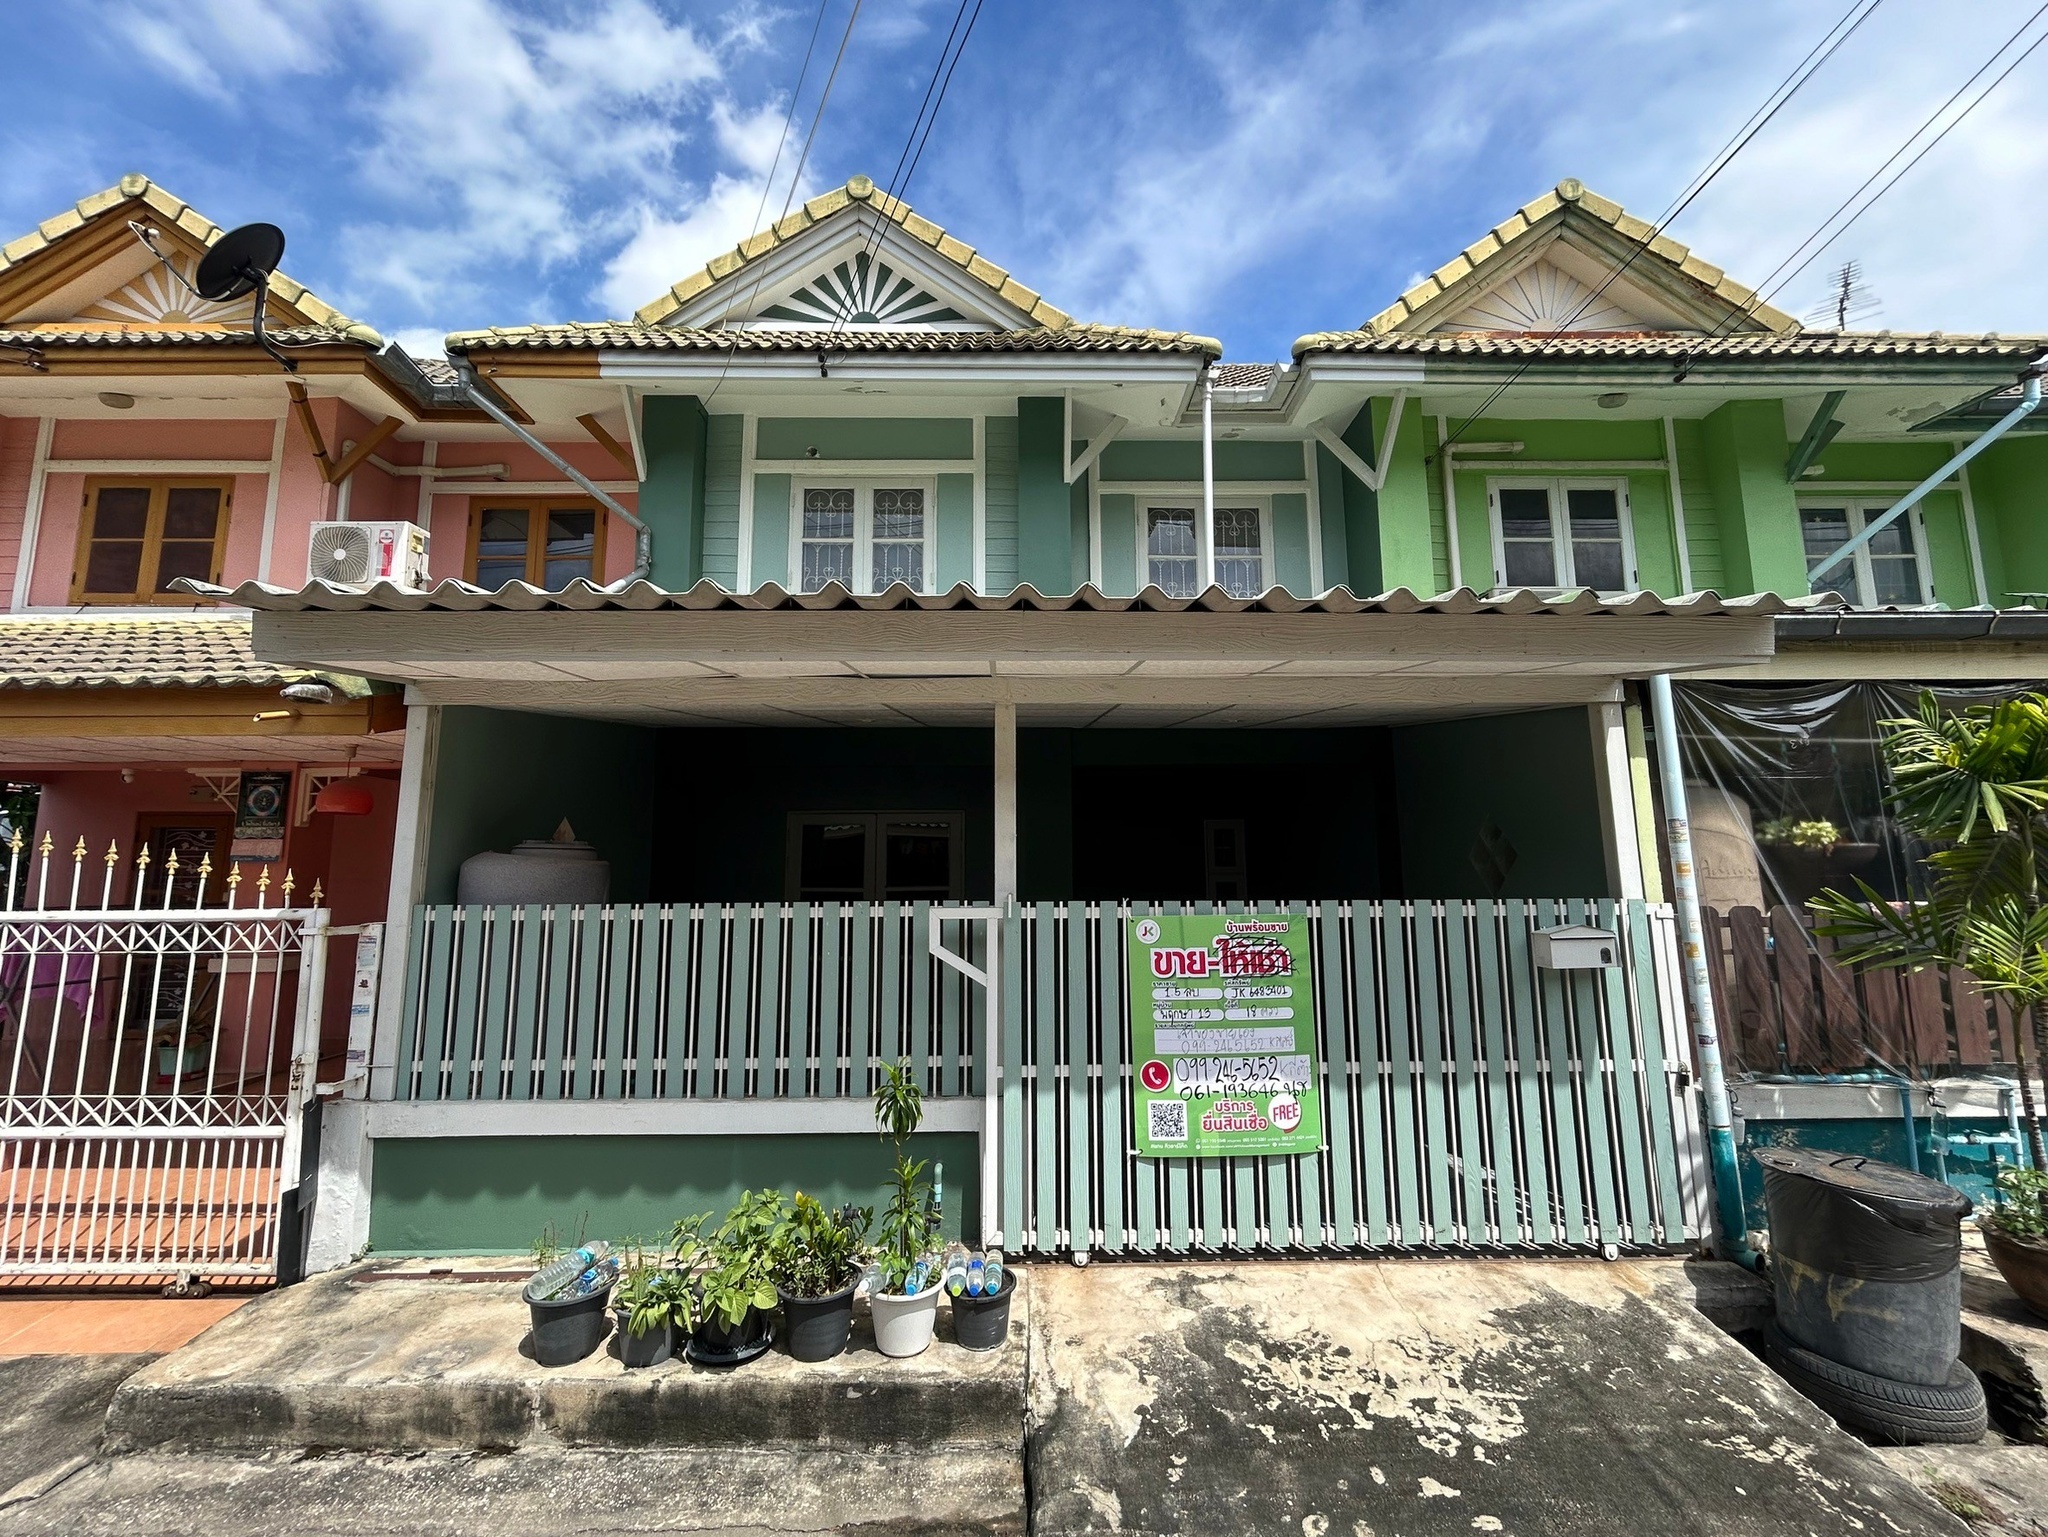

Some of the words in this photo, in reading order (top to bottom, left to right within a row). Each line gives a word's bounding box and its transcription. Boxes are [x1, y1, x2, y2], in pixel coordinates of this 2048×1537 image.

[1142, 926, 1154, 937] JK
[1226, 920, 1288, 932] บ้านพร้อมขาย
[1198, 1007, 1212, 1019] 13
[1246, 1004, 1257, 1018] 18
[1215, 1099, 1254, 1112] บริการ
[1272, 1103, 1300, 1123] FREE
[1202, 1110, 1267, 1131] ยื่นสินเชื่อ
